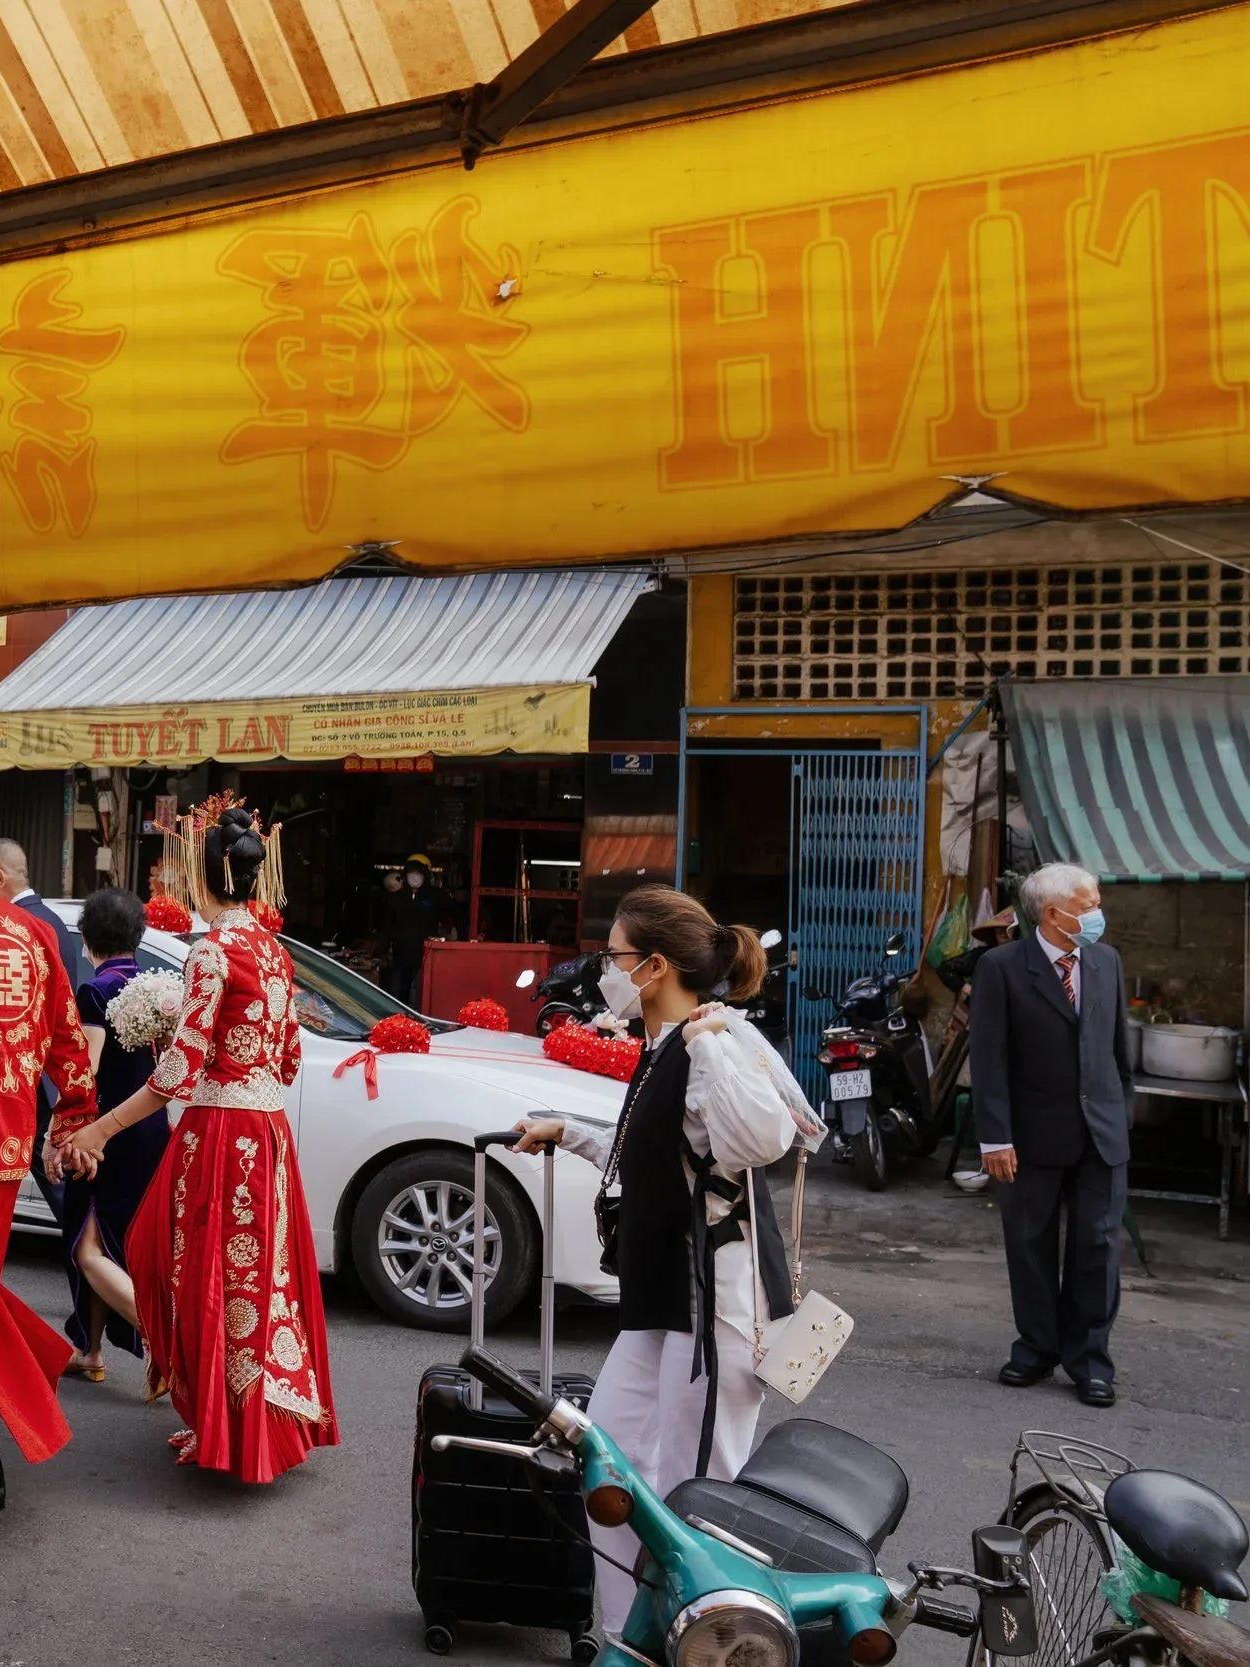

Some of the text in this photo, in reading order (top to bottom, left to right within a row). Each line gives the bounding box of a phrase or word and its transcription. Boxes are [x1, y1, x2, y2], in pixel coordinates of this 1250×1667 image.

[386, 713, 415, 726] CÔNG
[87, 707, 294, 759] TUYẾT LAN
[625, 754, 640, 768] 2
